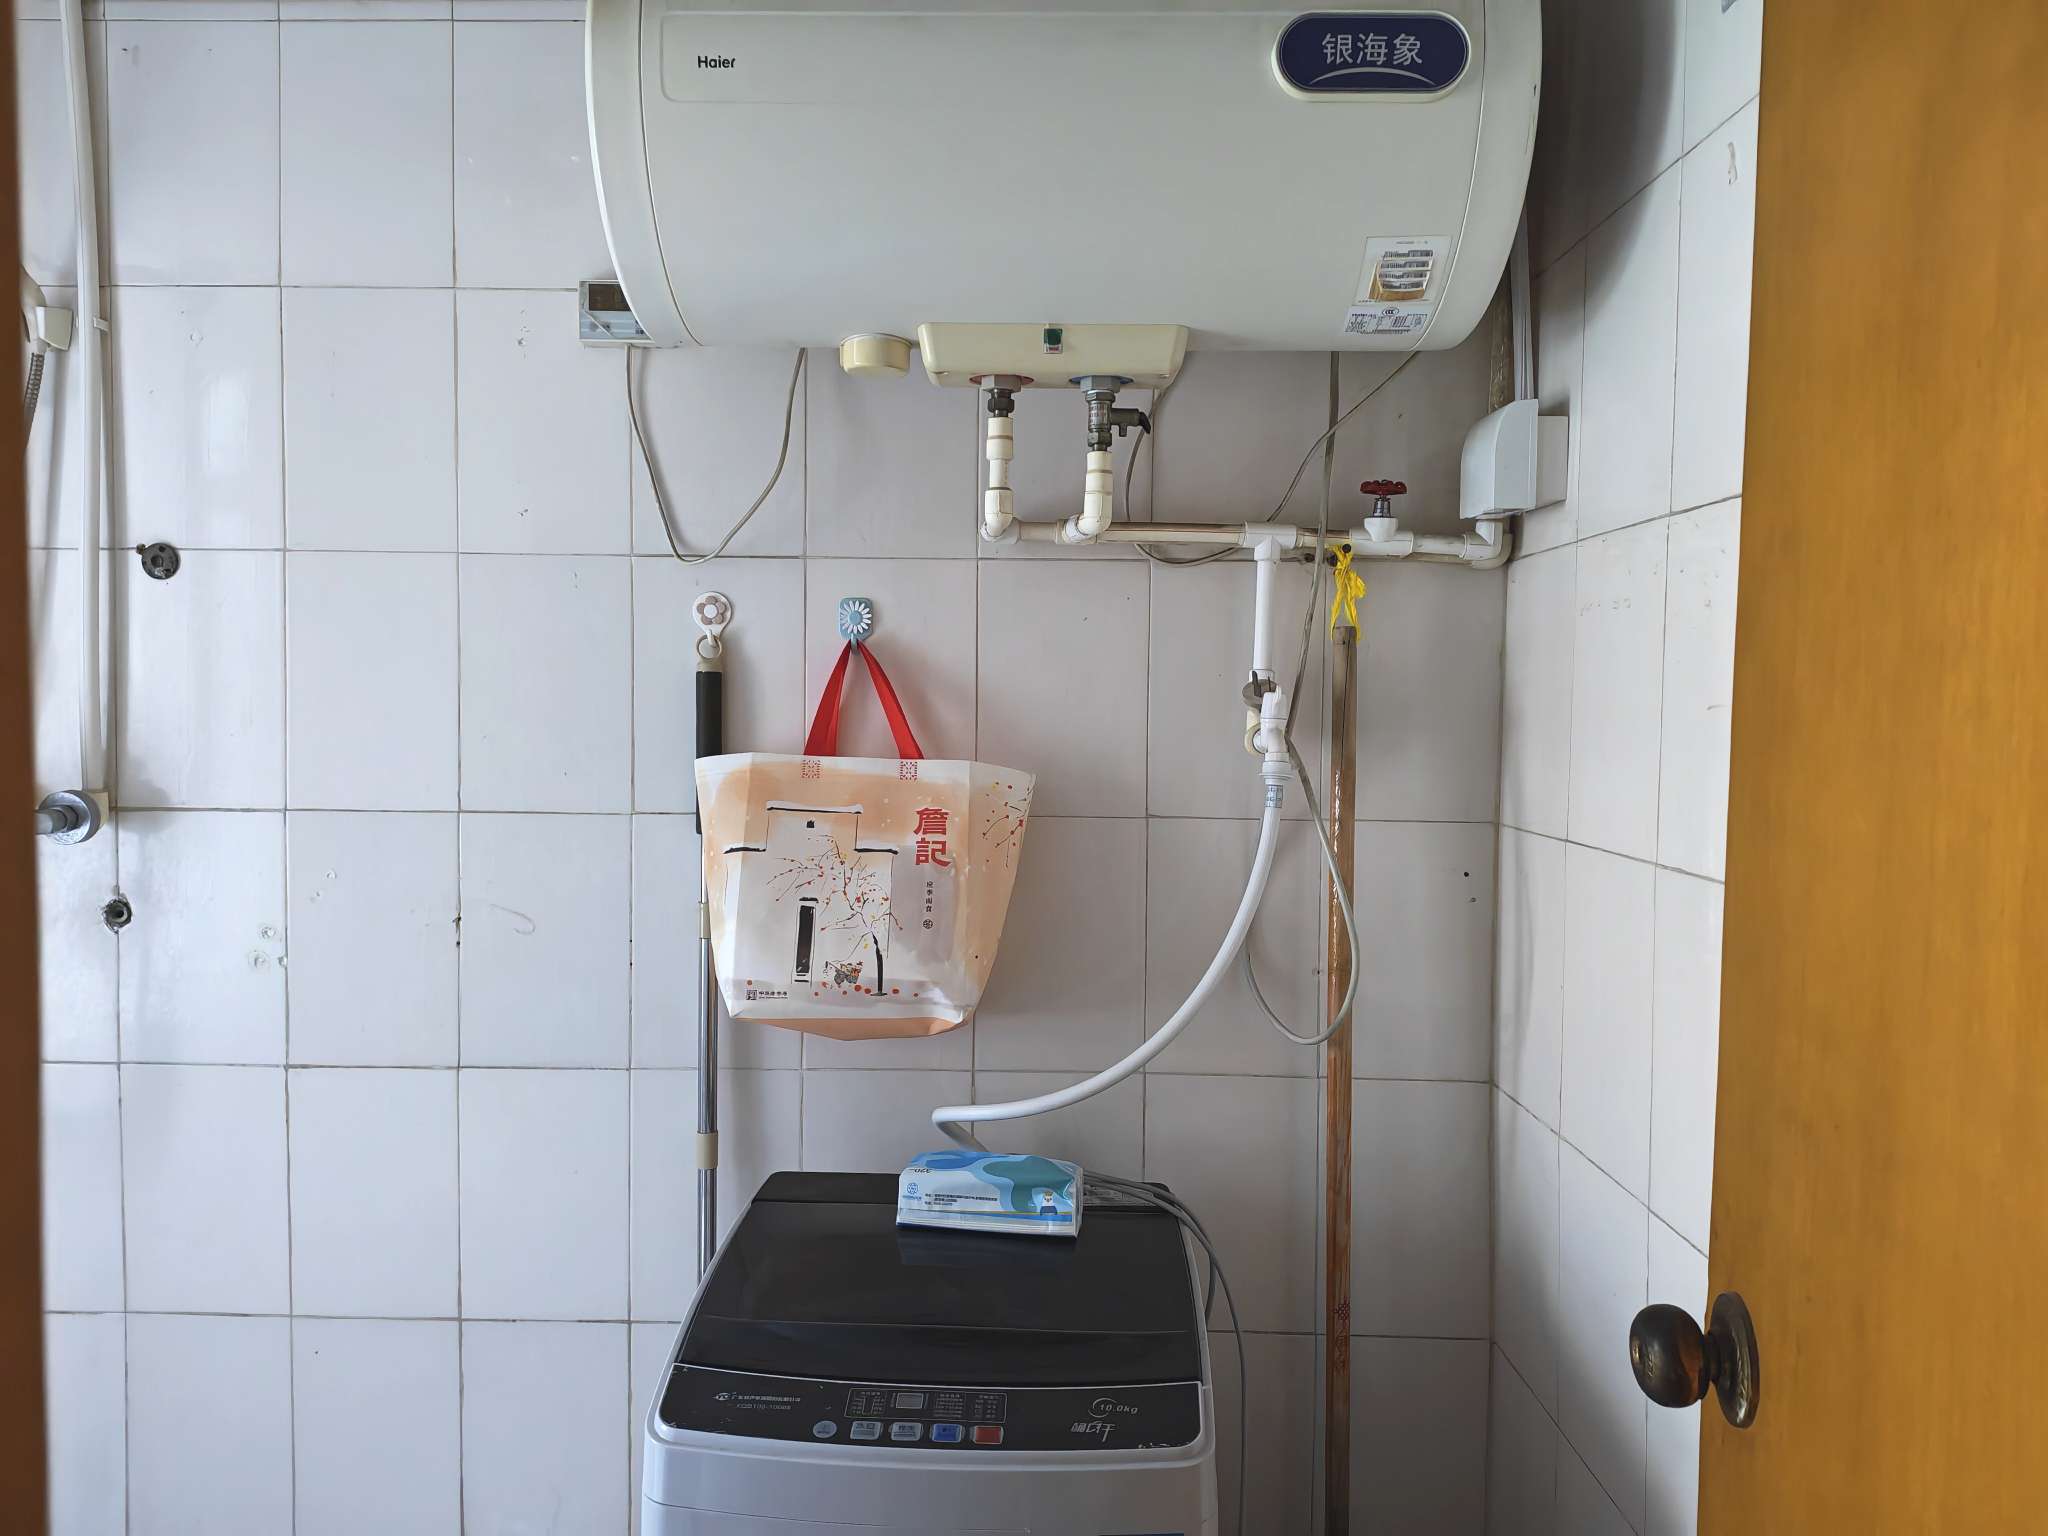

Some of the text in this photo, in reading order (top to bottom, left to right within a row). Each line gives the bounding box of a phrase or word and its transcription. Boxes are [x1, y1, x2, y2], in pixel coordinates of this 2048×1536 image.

[1321, 32, 1423, 66] 银海象
[697, 54, 736, 69] Haier
[913, 807, 952, 867] 詹記
[1099, 1403, 1138, 1415] 10.0kg
